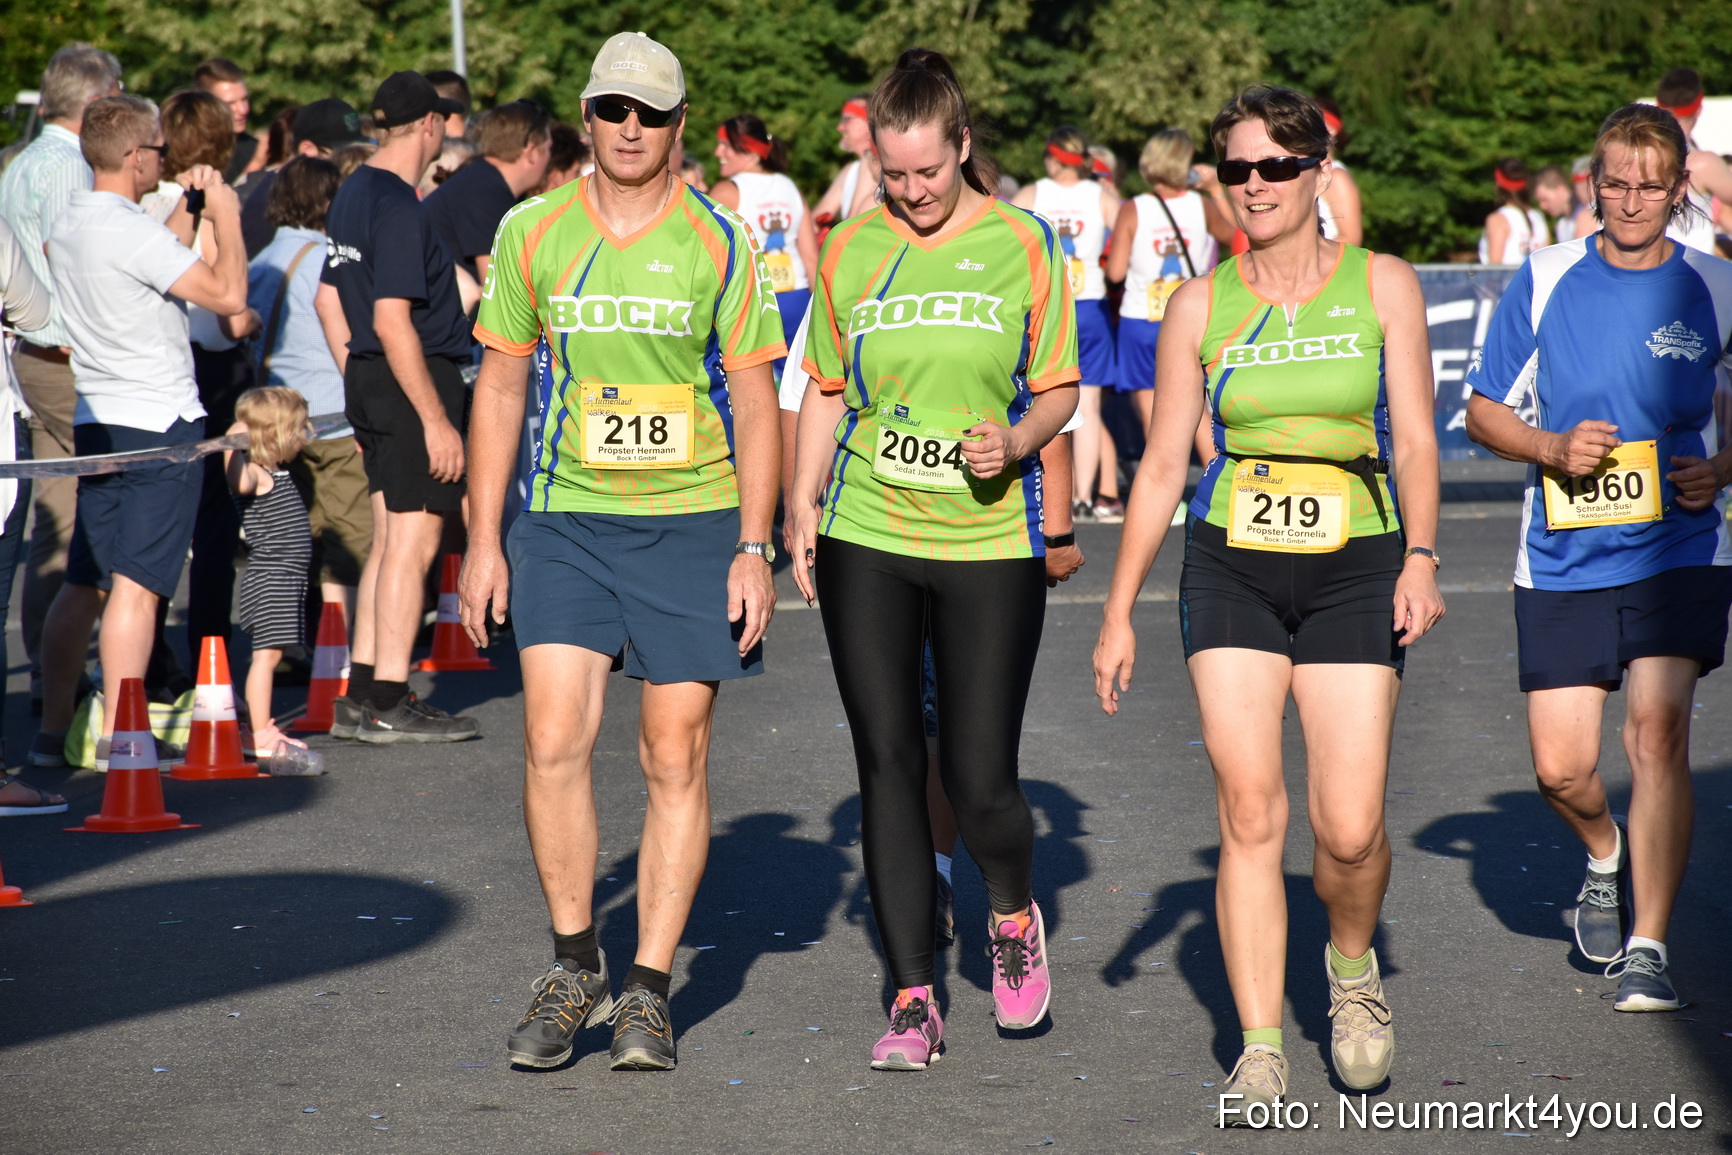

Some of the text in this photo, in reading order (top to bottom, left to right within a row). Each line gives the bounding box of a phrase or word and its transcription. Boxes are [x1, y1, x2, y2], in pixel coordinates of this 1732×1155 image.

[610, 60, 649, 73] BOCK
[548, 295, 695, 336] BOCK
[848, 291, 1004, 341] BOCK
[1652, 335, 1702, 348] TRANSpofix
[1222, 333, 1364, 369] BOCK
[595, 397, 633, 406] firmenlauf
[604, 415, 668, 445] 218
[598, 446, 676, 455] Pröpster Hermann
[880, 429, 963, 471] 2084
[894, 464, 945, 479] Sedat Jasmin
[1246, 472, 1284, 485] firmenlauf
[1560, 471, 1644, 505] 1960
[1252, 493, 1320, 528] 219
[1575, 502, 1632, 513] Schraufl Susi
[1246, 525, 1327, 538] Pröpster Cornelia
